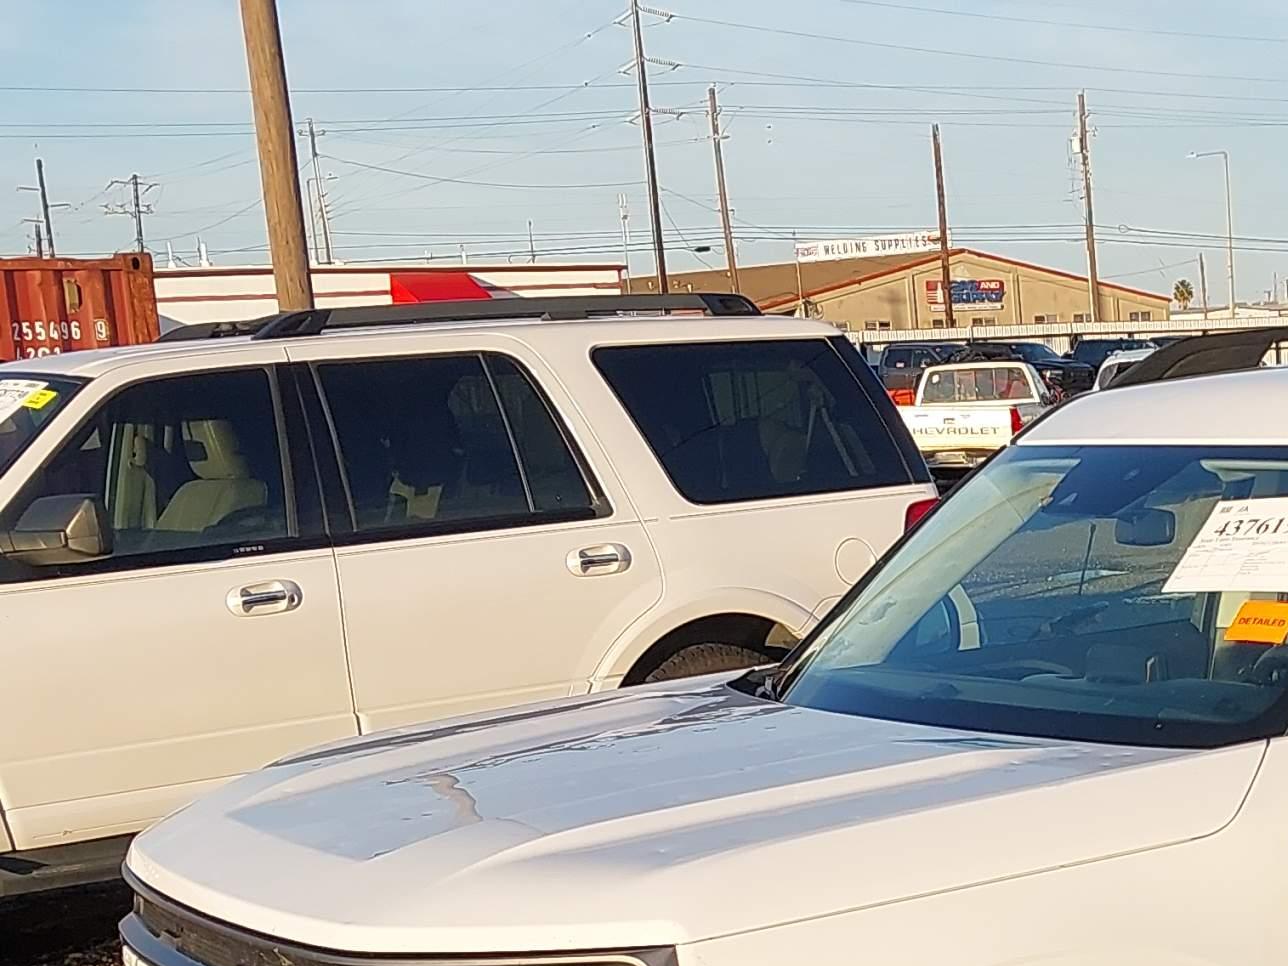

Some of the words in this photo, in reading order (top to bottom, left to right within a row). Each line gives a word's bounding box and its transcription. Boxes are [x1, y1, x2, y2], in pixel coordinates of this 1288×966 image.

[874, 235, 928, 251] SUPPLIES
[980, 281, 1000, 289] AND
[12, 321, 80, 341] 255496
[95, 321, 107, 340] 9
[912, 426, 1000, 435] HEVROLET
[1238, 617, 1286, 627] DETAILED
